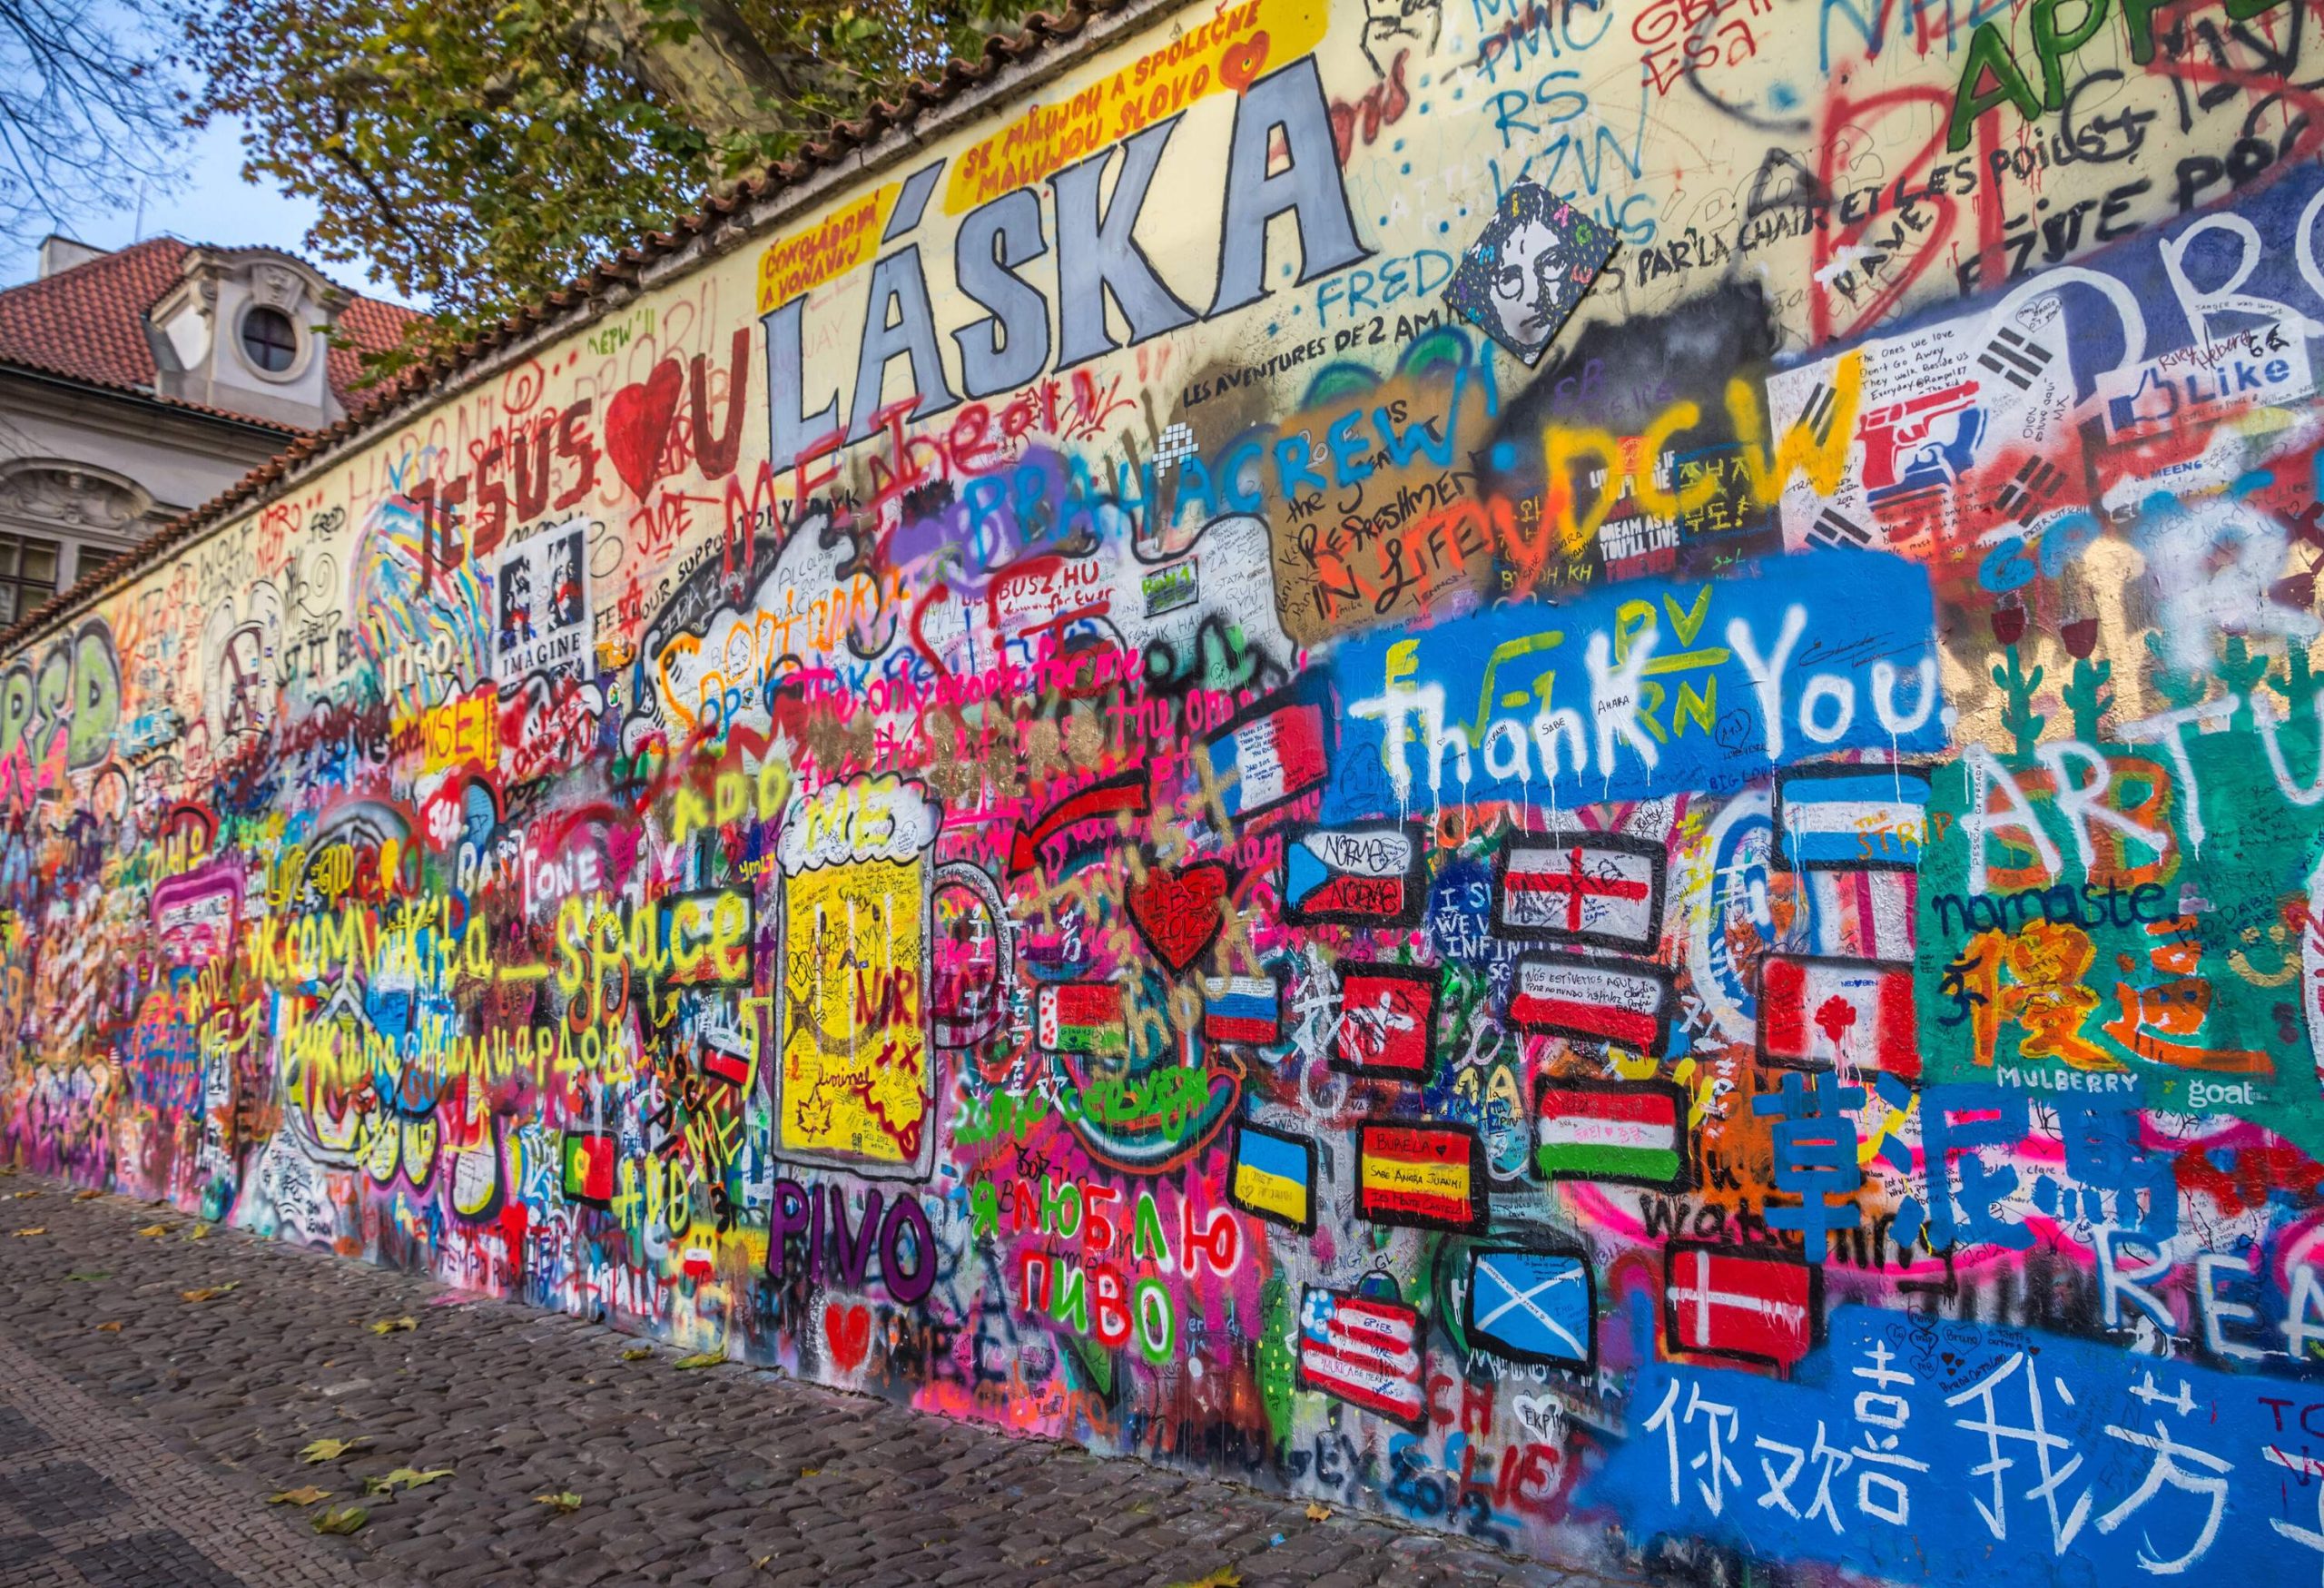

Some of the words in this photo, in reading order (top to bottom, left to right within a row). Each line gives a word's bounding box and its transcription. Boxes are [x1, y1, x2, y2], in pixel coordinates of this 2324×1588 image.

[1110, 73, 1126, 101] A
[976, 125, 1101, 202] MALUJOU
[1114, 64, 1210, 137] SLOVO
[1837, 184, 1878, 226] ET
[759, 53, 1379, 476] LÁSKA
[1183, 380, 1212, 409] LES
[1215, 335, 1326, 399] AVENTURES
[1334, 325, 1366, 351] DE
[1368, 316, 1388, 345] 2
[1915, 347, 1945, 364] Away
[2185, 359, 2290, 405] Like
[409, 397, 602, 602] JESUS
[689, 326, 751, 483] U
[1599, 517, 1643, 543] DREAM
[1599, 534, 1648, 563] YOU'LL
[1648, 526, 1680, 552] LIVE
[502, 631, 582, 677] IMAGINE
[1858, 812, 1953, 862] STRIP
[1996, 1064, 2140, 1093] MULBERRY
[2187, 1078, 2255, 1110] goat
[1374, 1133, 1432, 1153] BURELA
[766, 1178, 939, 1306] PIVO
[970, 1179, 1000, 1240] Я
[1010, 1173, 1245, 1278] ЛЮБЛЮ
[1018, 1247, 1177, 1366] ПИВО
